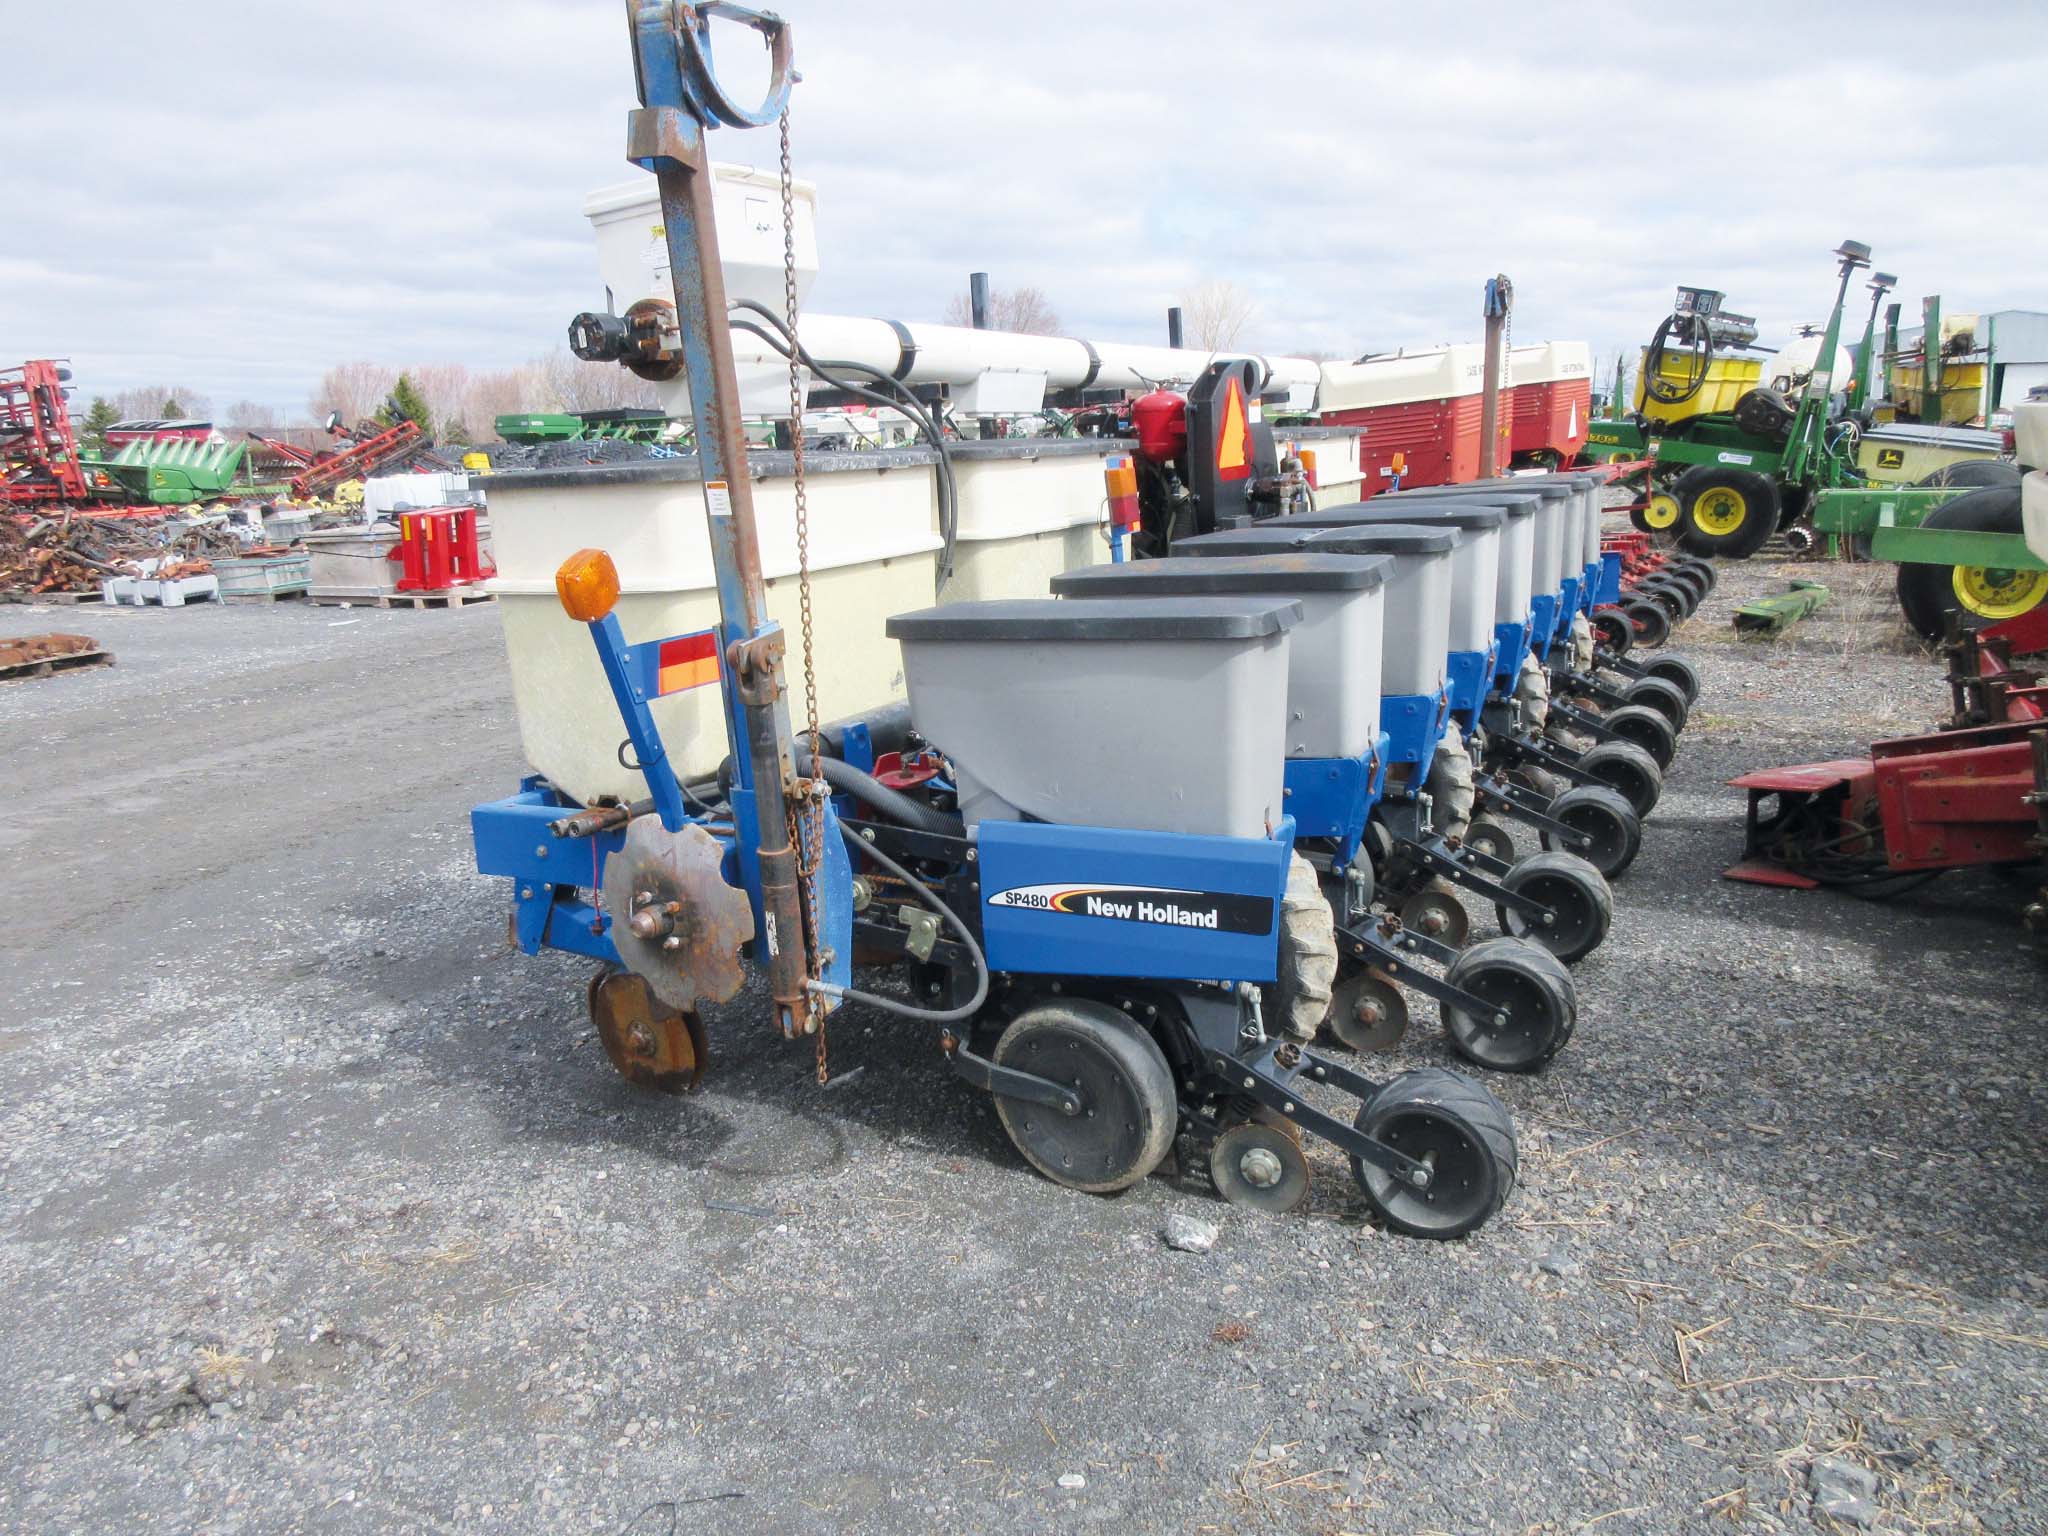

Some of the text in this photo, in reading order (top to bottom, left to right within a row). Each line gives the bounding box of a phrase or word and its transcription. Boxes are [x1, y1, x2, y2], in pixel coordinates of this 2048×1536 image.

[1005, 891, 1049, 908] SP480
[1087, 896, 1218, 929] New Holland
